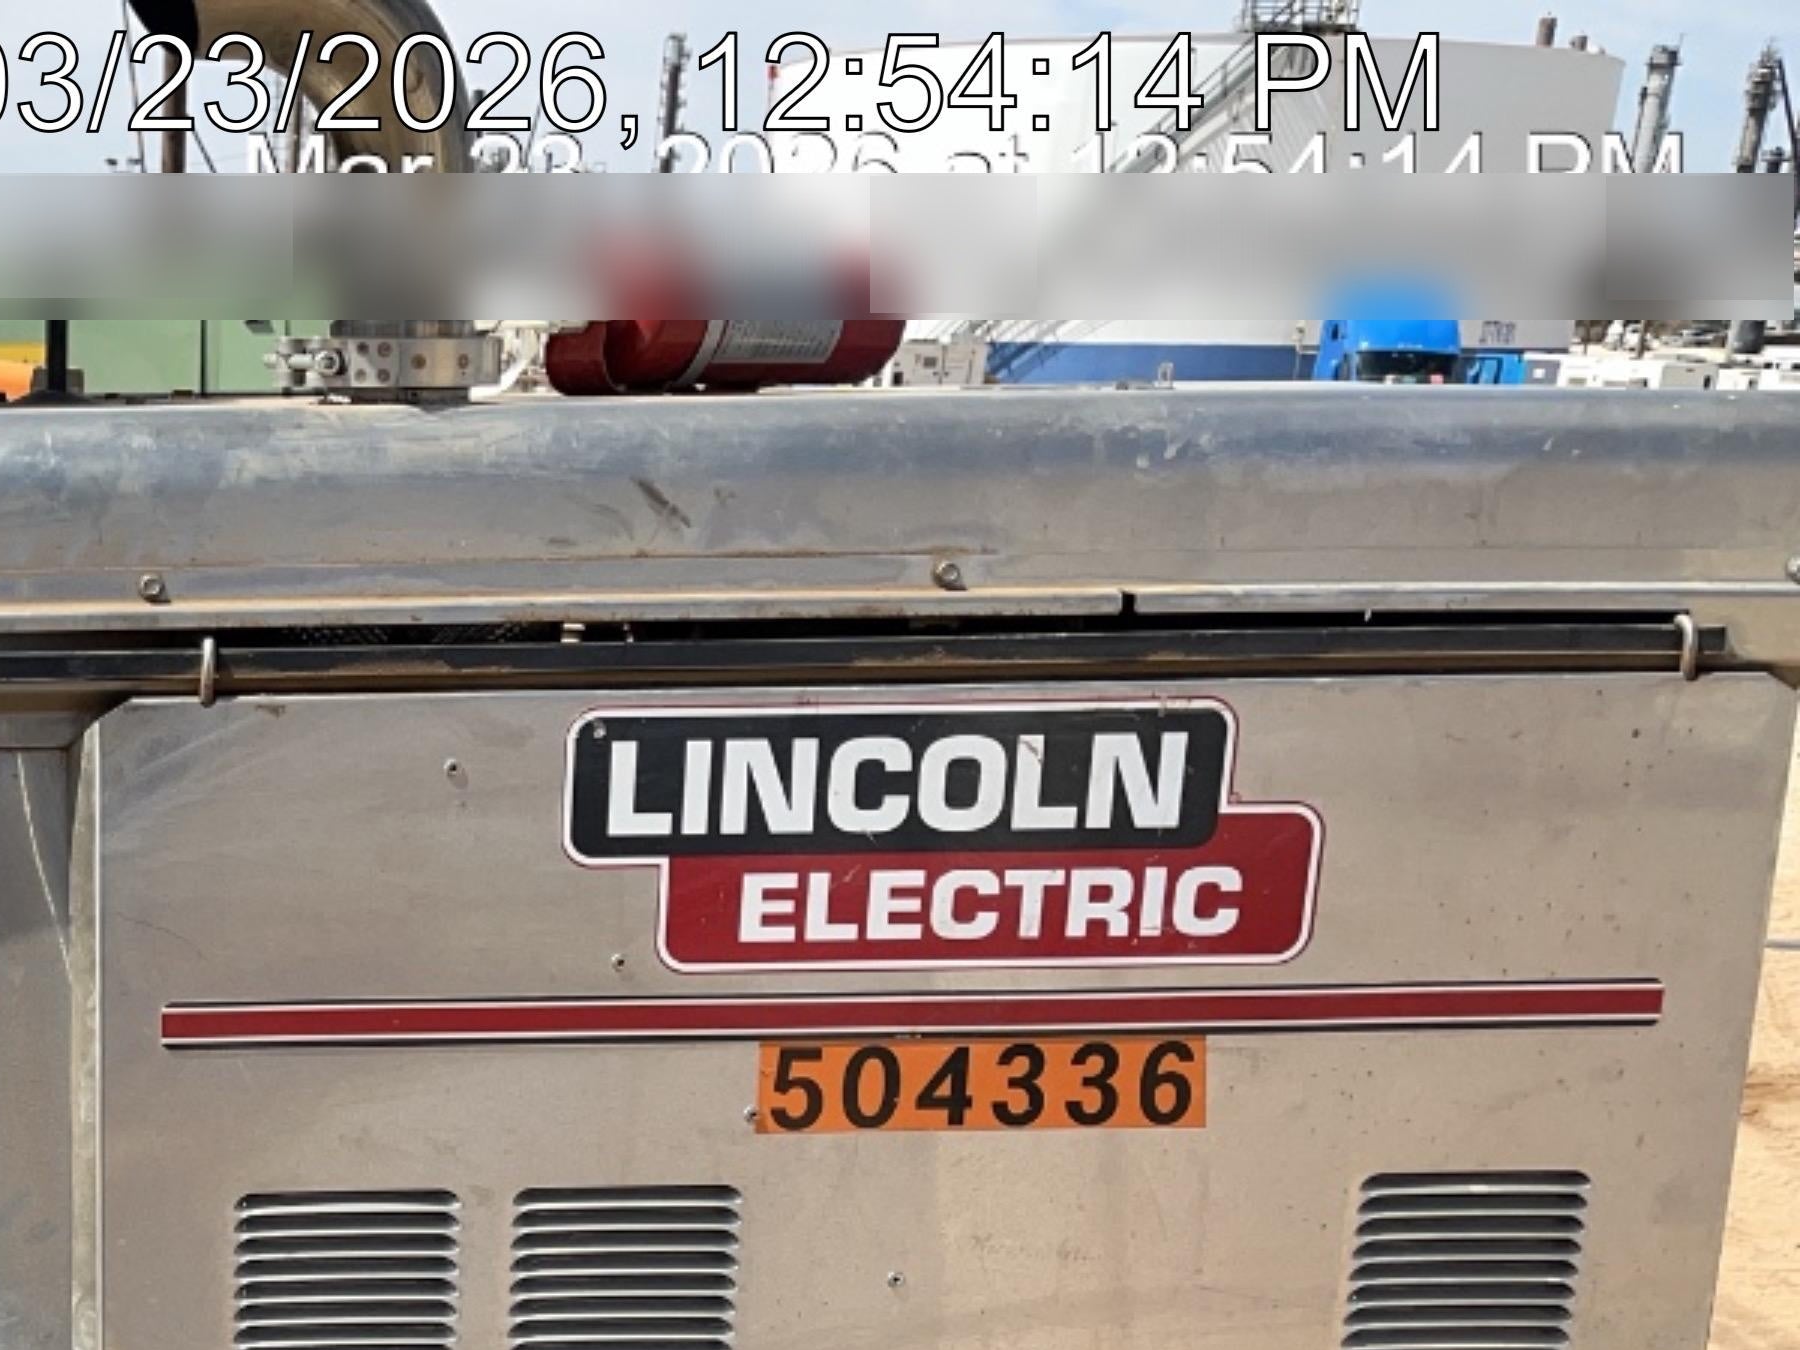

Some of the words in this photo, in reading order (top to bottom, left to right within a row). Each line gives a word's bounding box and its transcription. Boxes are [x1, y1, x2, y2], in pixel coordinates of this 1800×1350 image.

[605, 731, 1189, 838] LINCOLN
[737, 865, 1243, 943] ELECTRIC
[768, 1040, 1196, 1131] 504336
